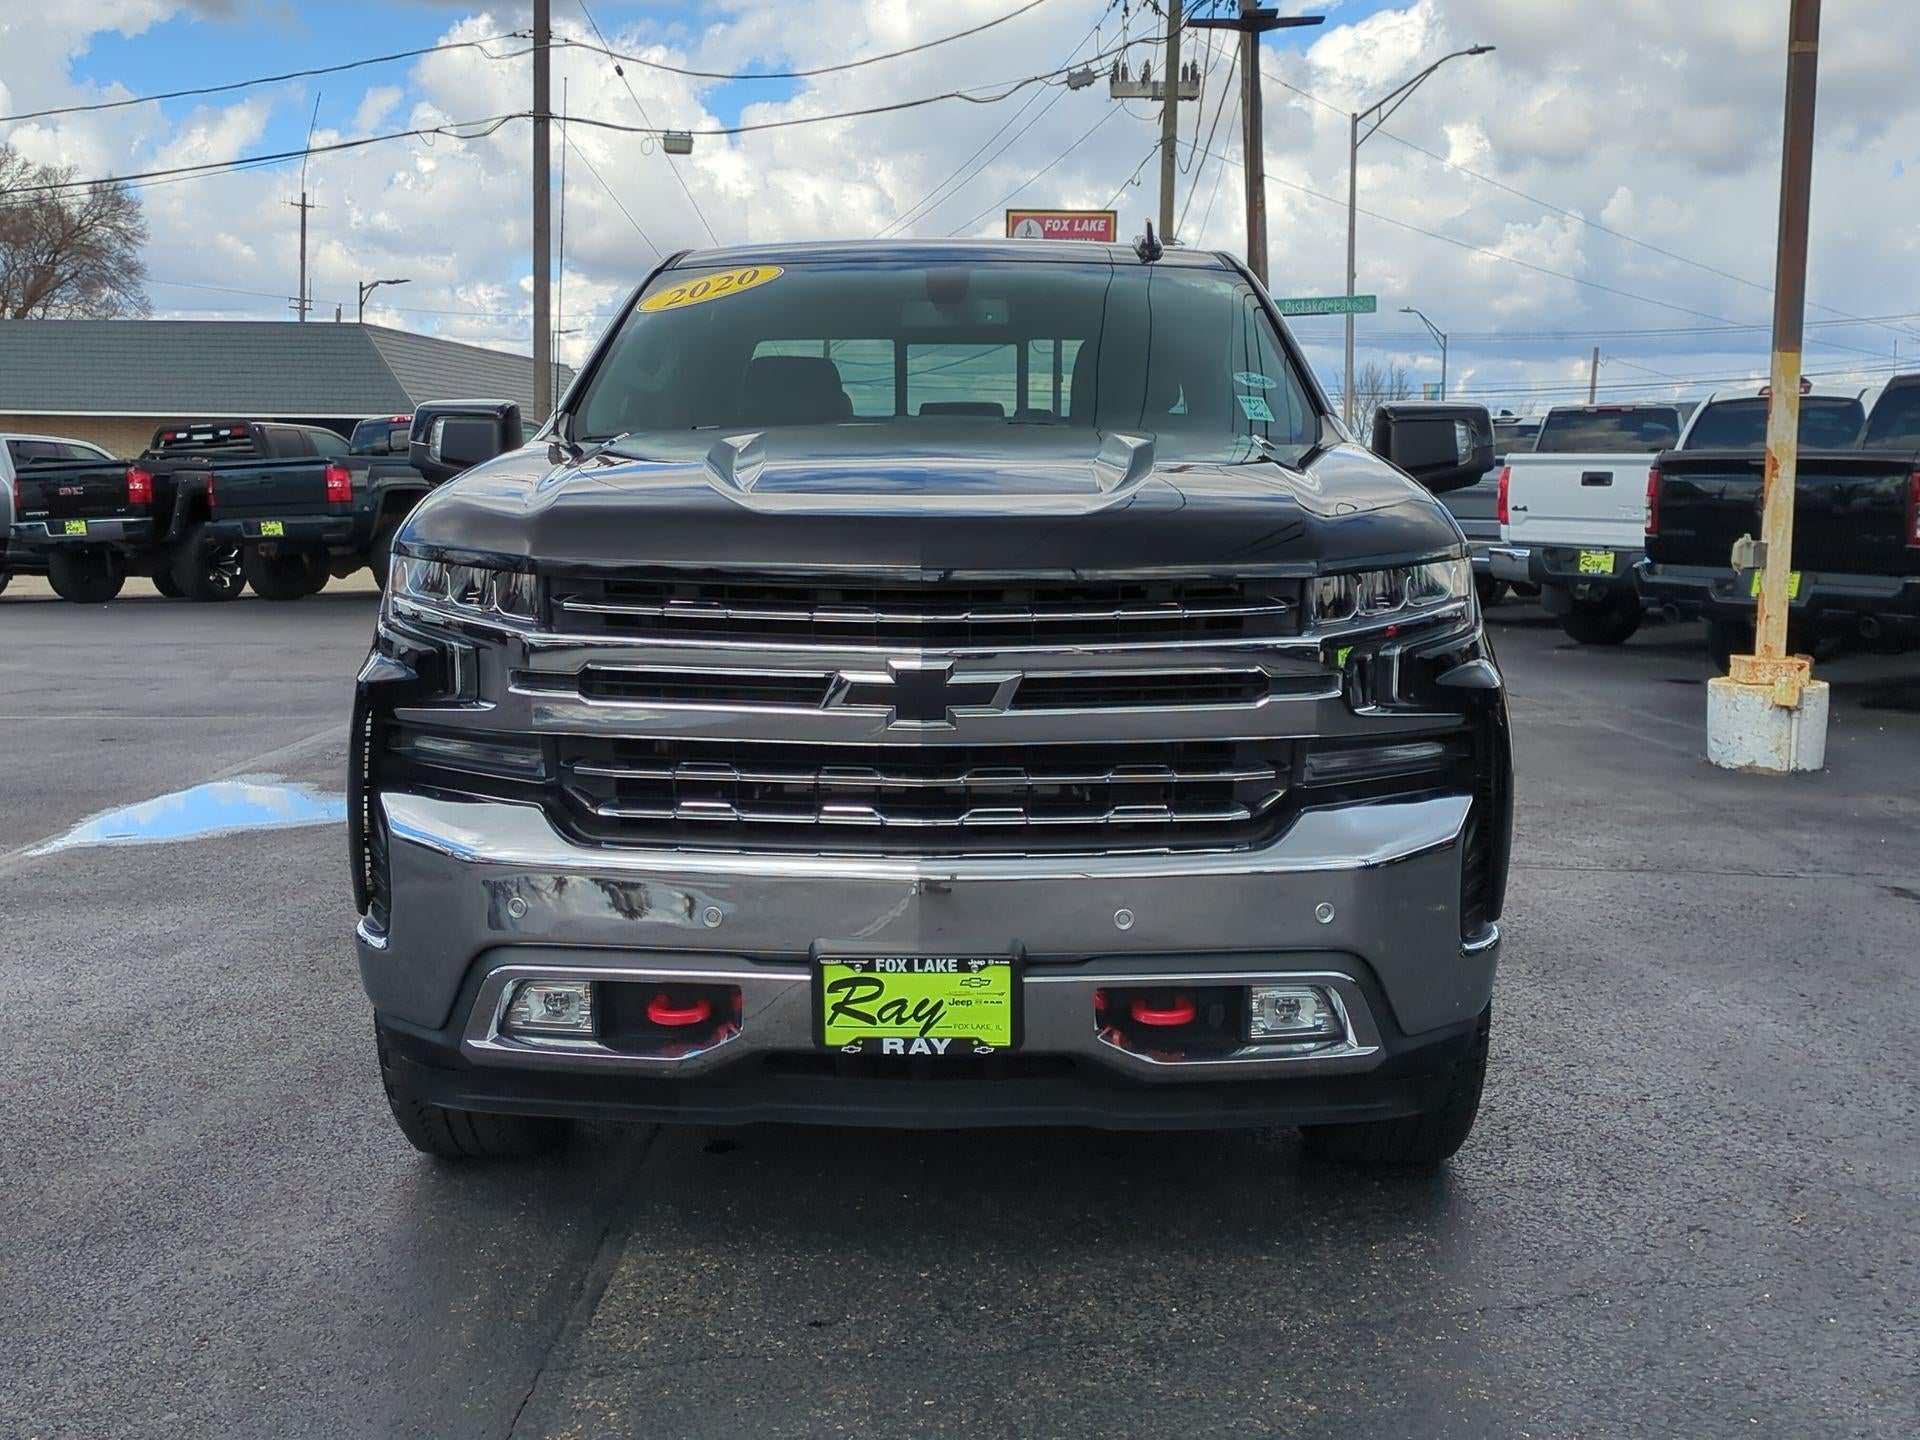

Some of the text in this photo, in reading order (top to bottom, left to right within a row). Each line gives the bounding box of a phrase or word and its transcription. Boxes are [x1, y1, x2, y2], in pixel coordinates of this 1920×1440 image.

[1044, 219, 1106, 232] FOX LAKE
[664, 269, 760, 307] 2020
[1581, 555, 1601, 570] Ray
[875, 958, 958, 973] FOX LAKE
[827, 976, 947, 1037] Ray
[948, 998, 973, 1007] Jeep
[882, 1038, 952, 1055] RAY
